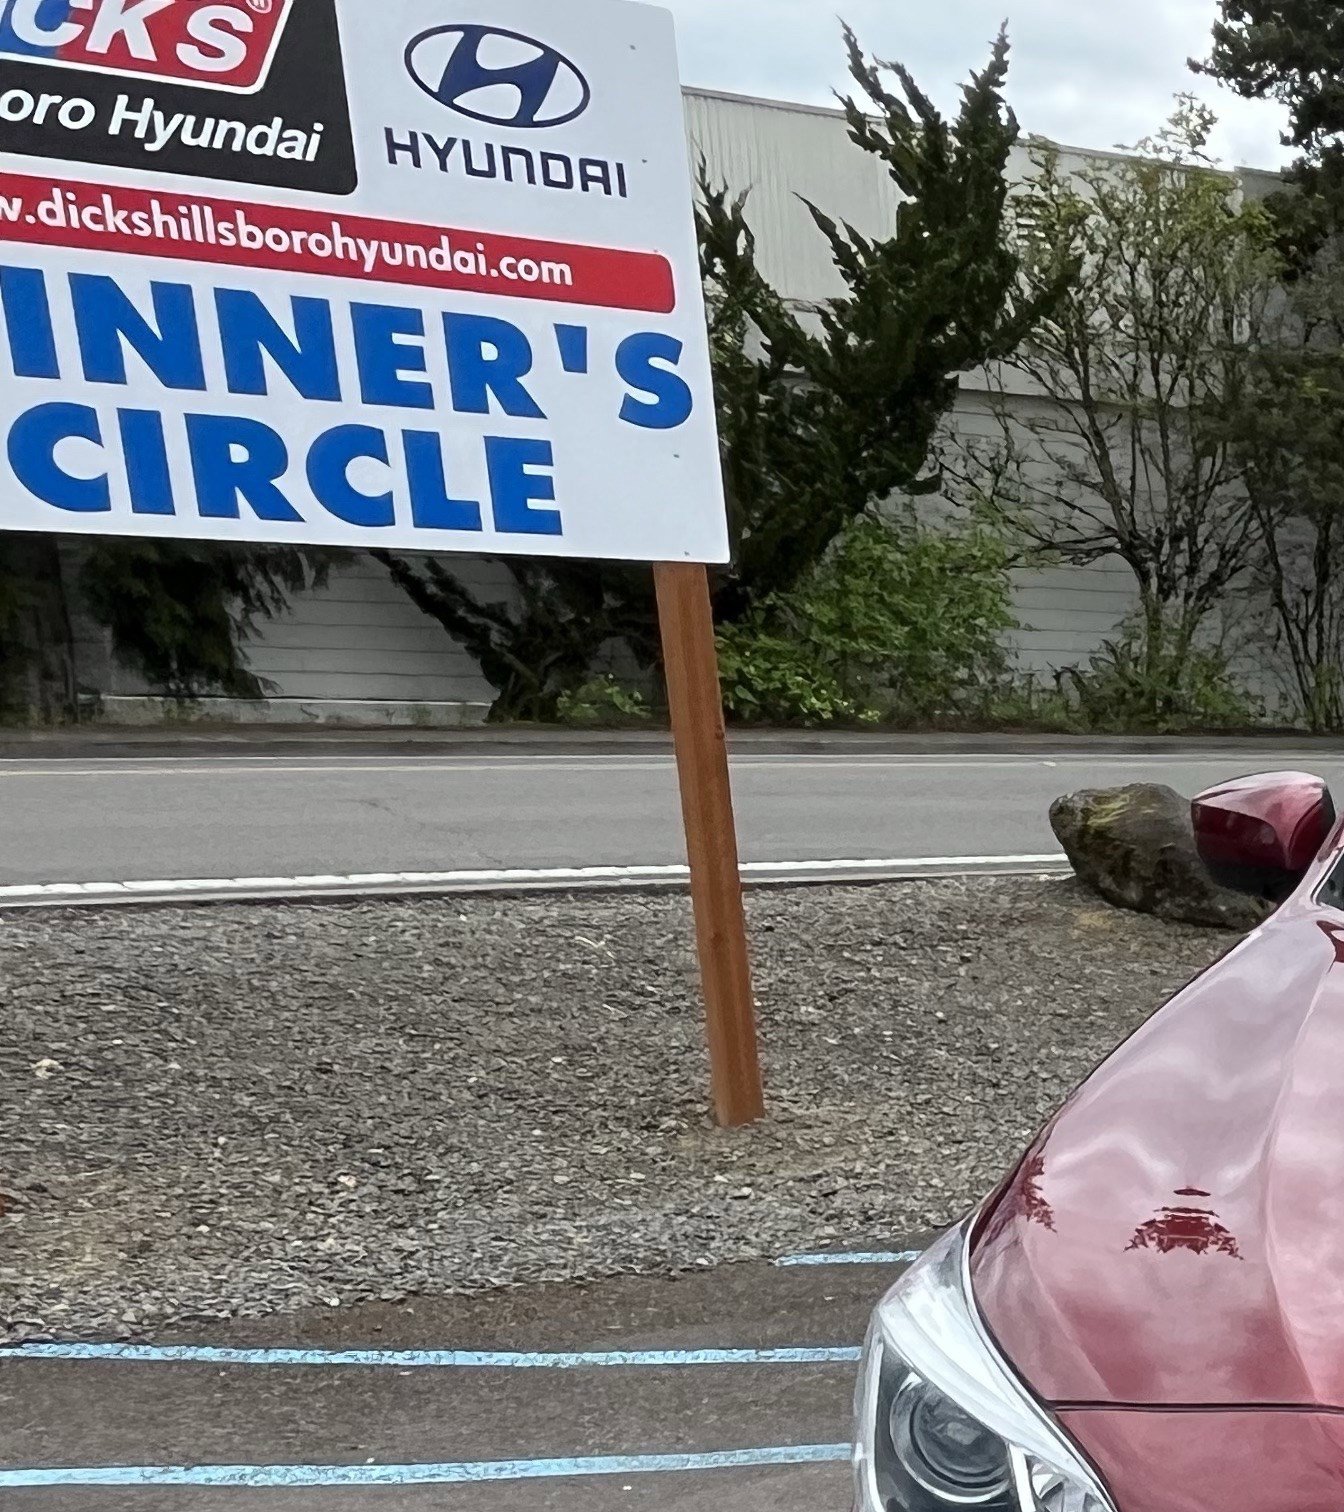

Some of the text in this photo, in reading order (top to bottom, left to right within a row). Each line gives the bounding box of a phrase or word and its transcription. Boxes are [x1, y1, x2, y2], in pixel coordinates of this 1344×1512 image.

[108, 94, 324, 162] Hyundai
[383, 126, 628, 198] HYUNDAI
[7, 401, 564, 537] CIRCLE
